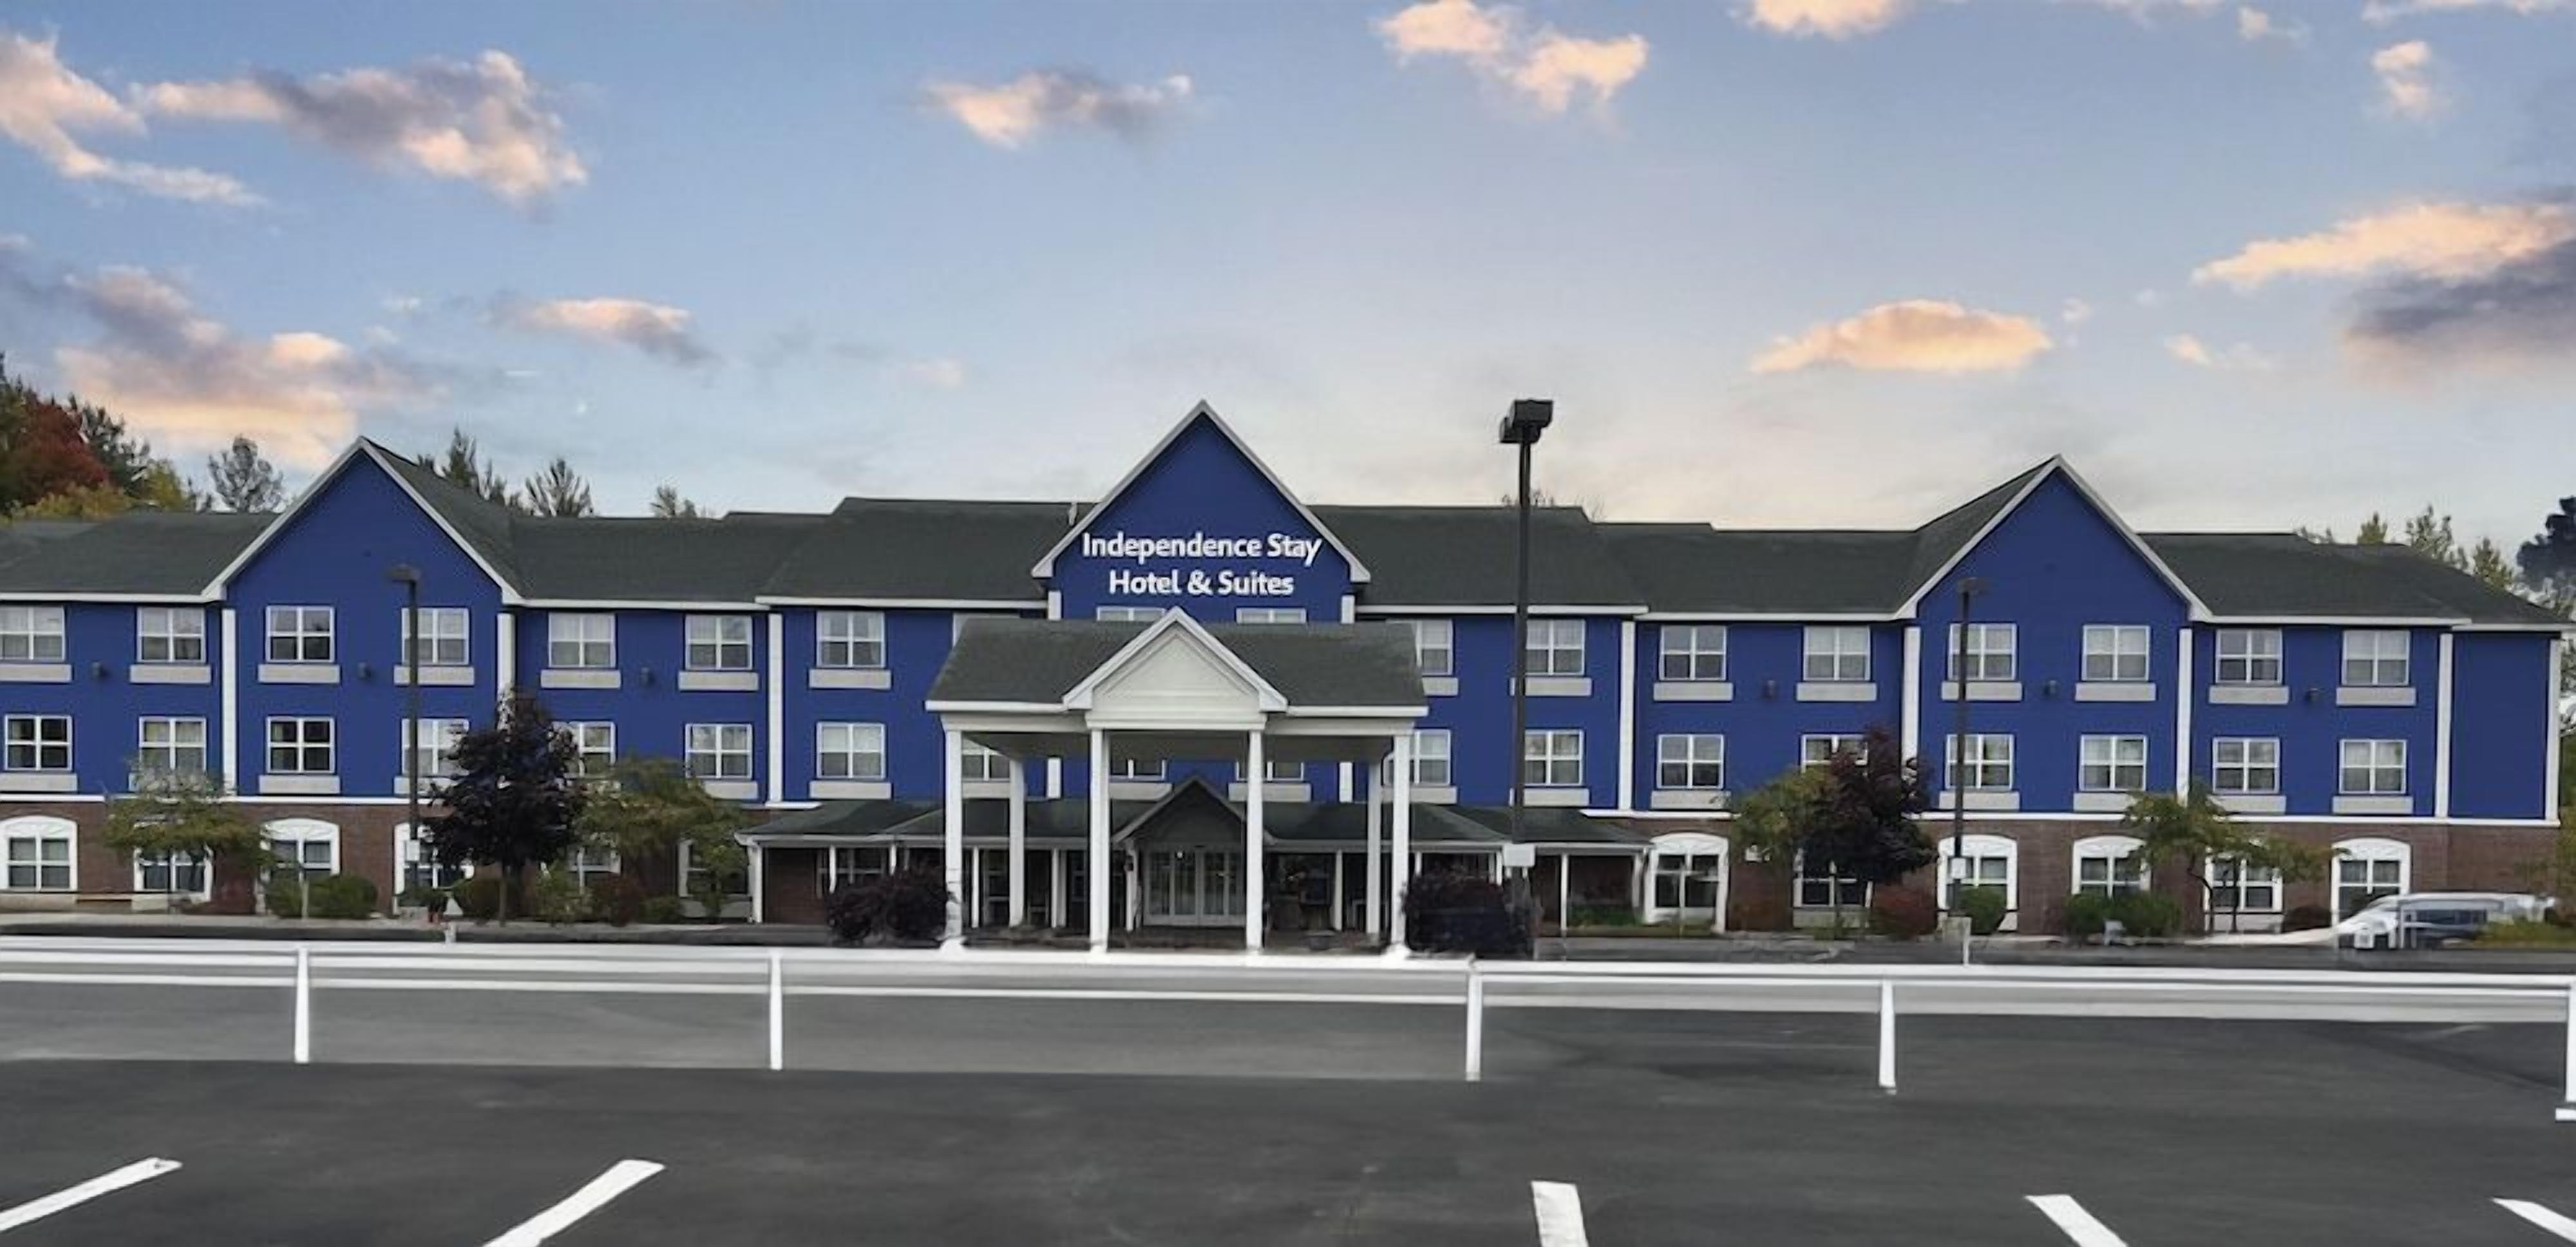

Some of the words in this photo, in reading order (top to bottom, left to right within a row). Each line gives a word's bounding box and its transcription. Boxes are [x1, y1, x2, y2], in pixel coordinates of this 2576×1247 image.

[1083, 531, 1262, 564] Independence
[1267, 533, 1322, 567] Stay
[1108, 569, 1181, 595] Hotel
[1187, 570, 1213, 595] &
[1217, 570, 1294, 595] Suites
